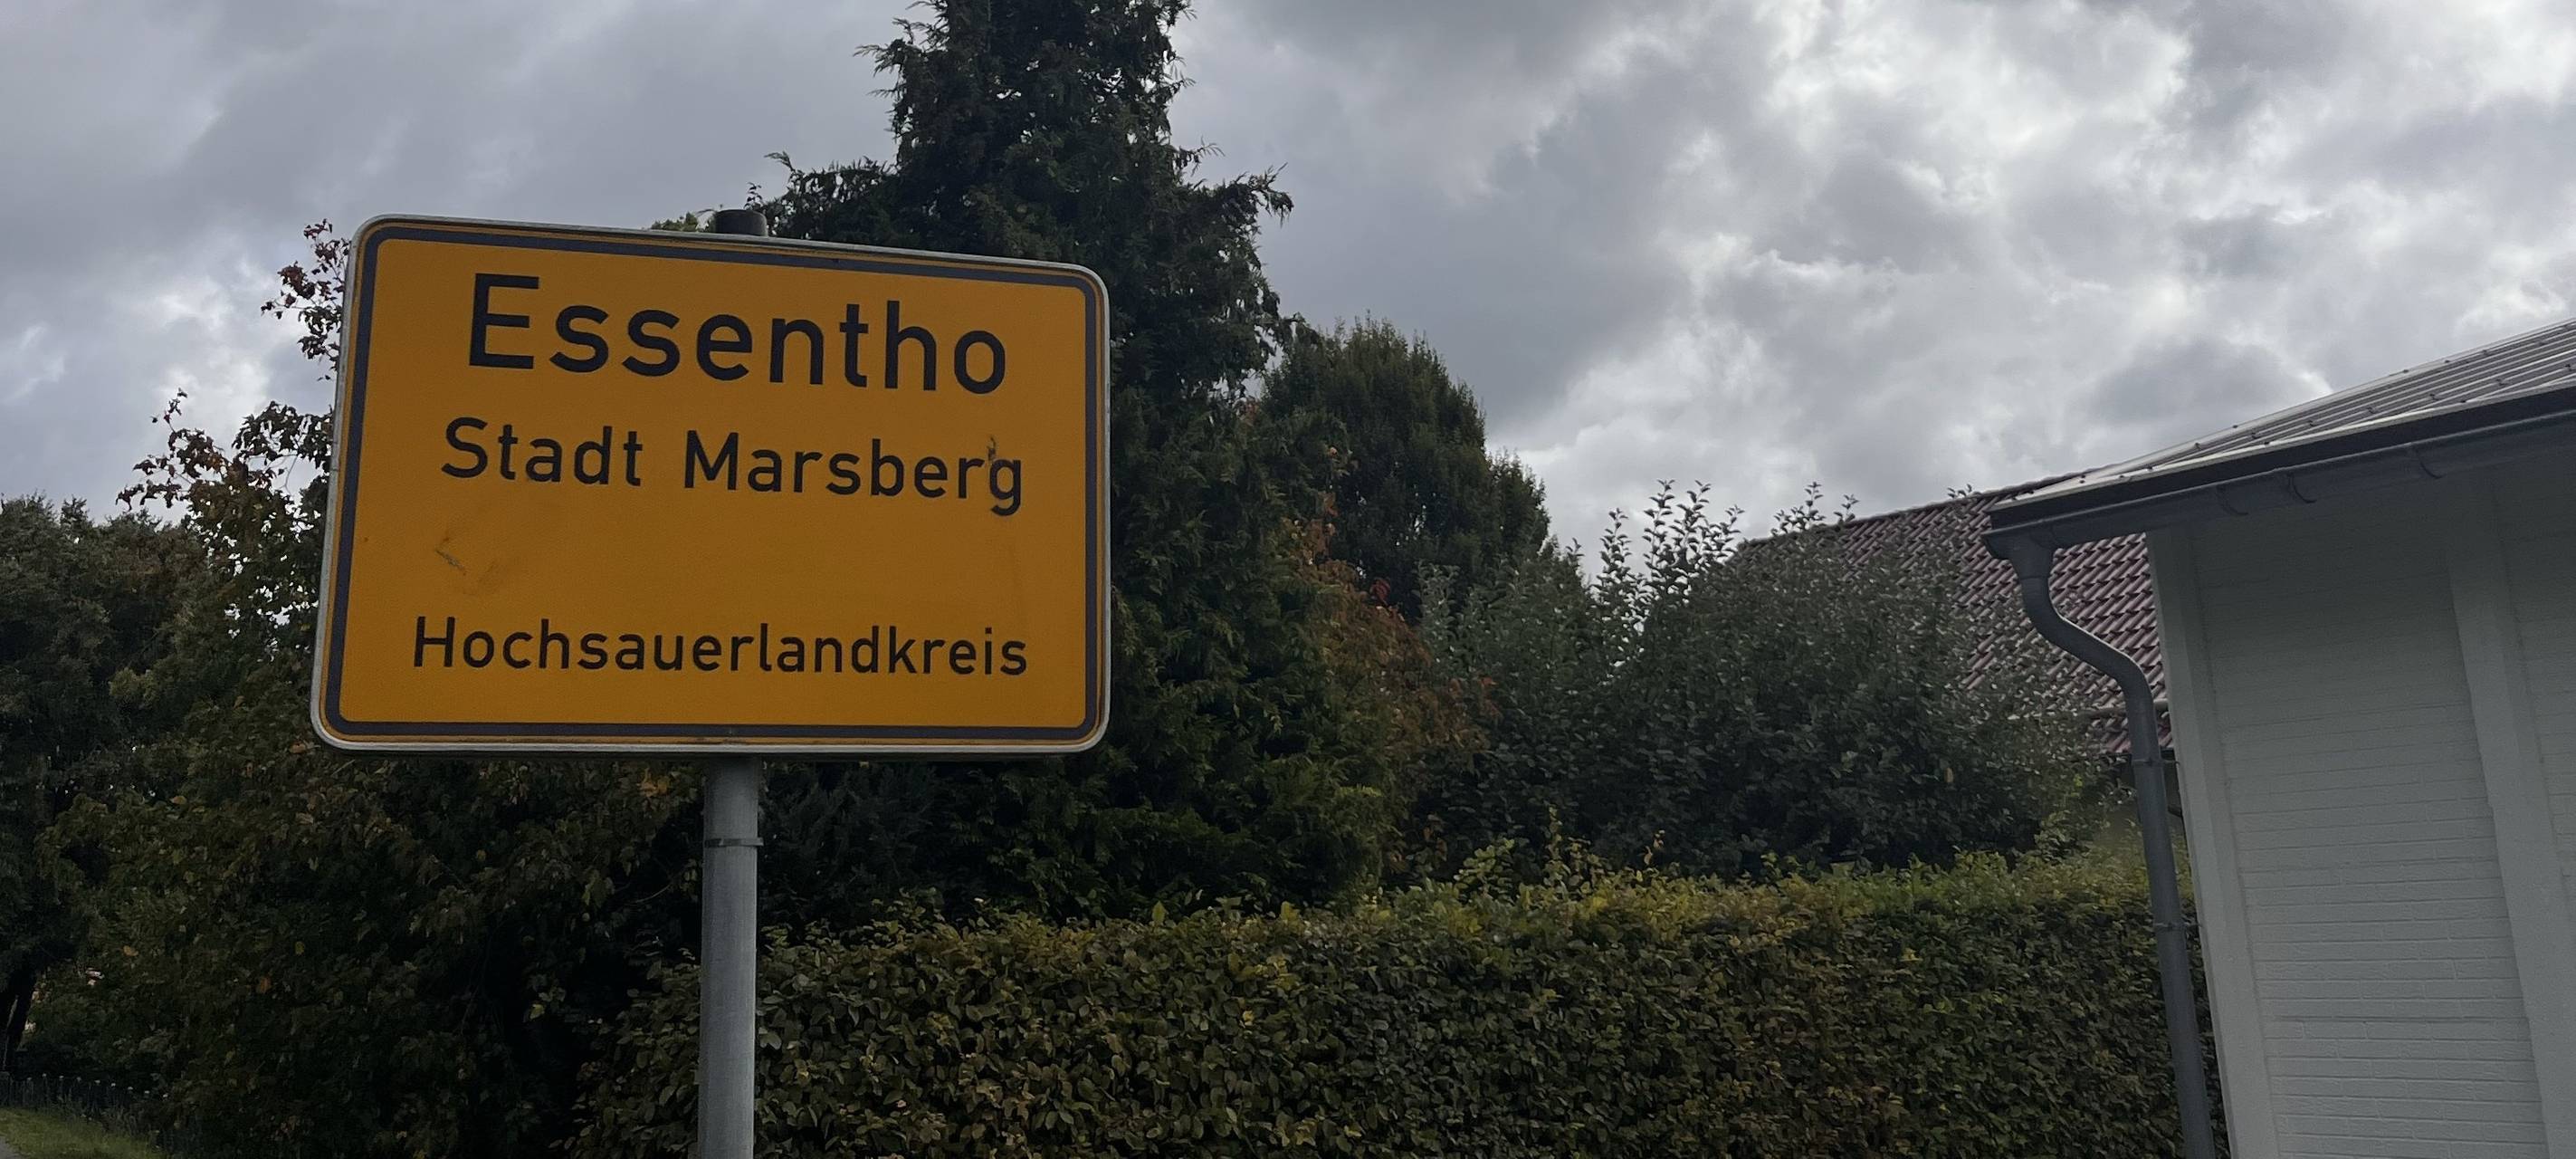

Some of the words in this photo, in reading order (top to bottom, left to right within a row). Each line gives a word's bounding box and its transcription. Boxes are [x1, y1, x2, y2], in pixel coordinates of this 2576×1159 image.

[468, 273, 1007, 396] Essentho
[441, 416, 644, 486] Stadt
[684, 430, 1023, 517] Marsberg
[413, 616, 1027, 676] Hochsauerlandkreis
